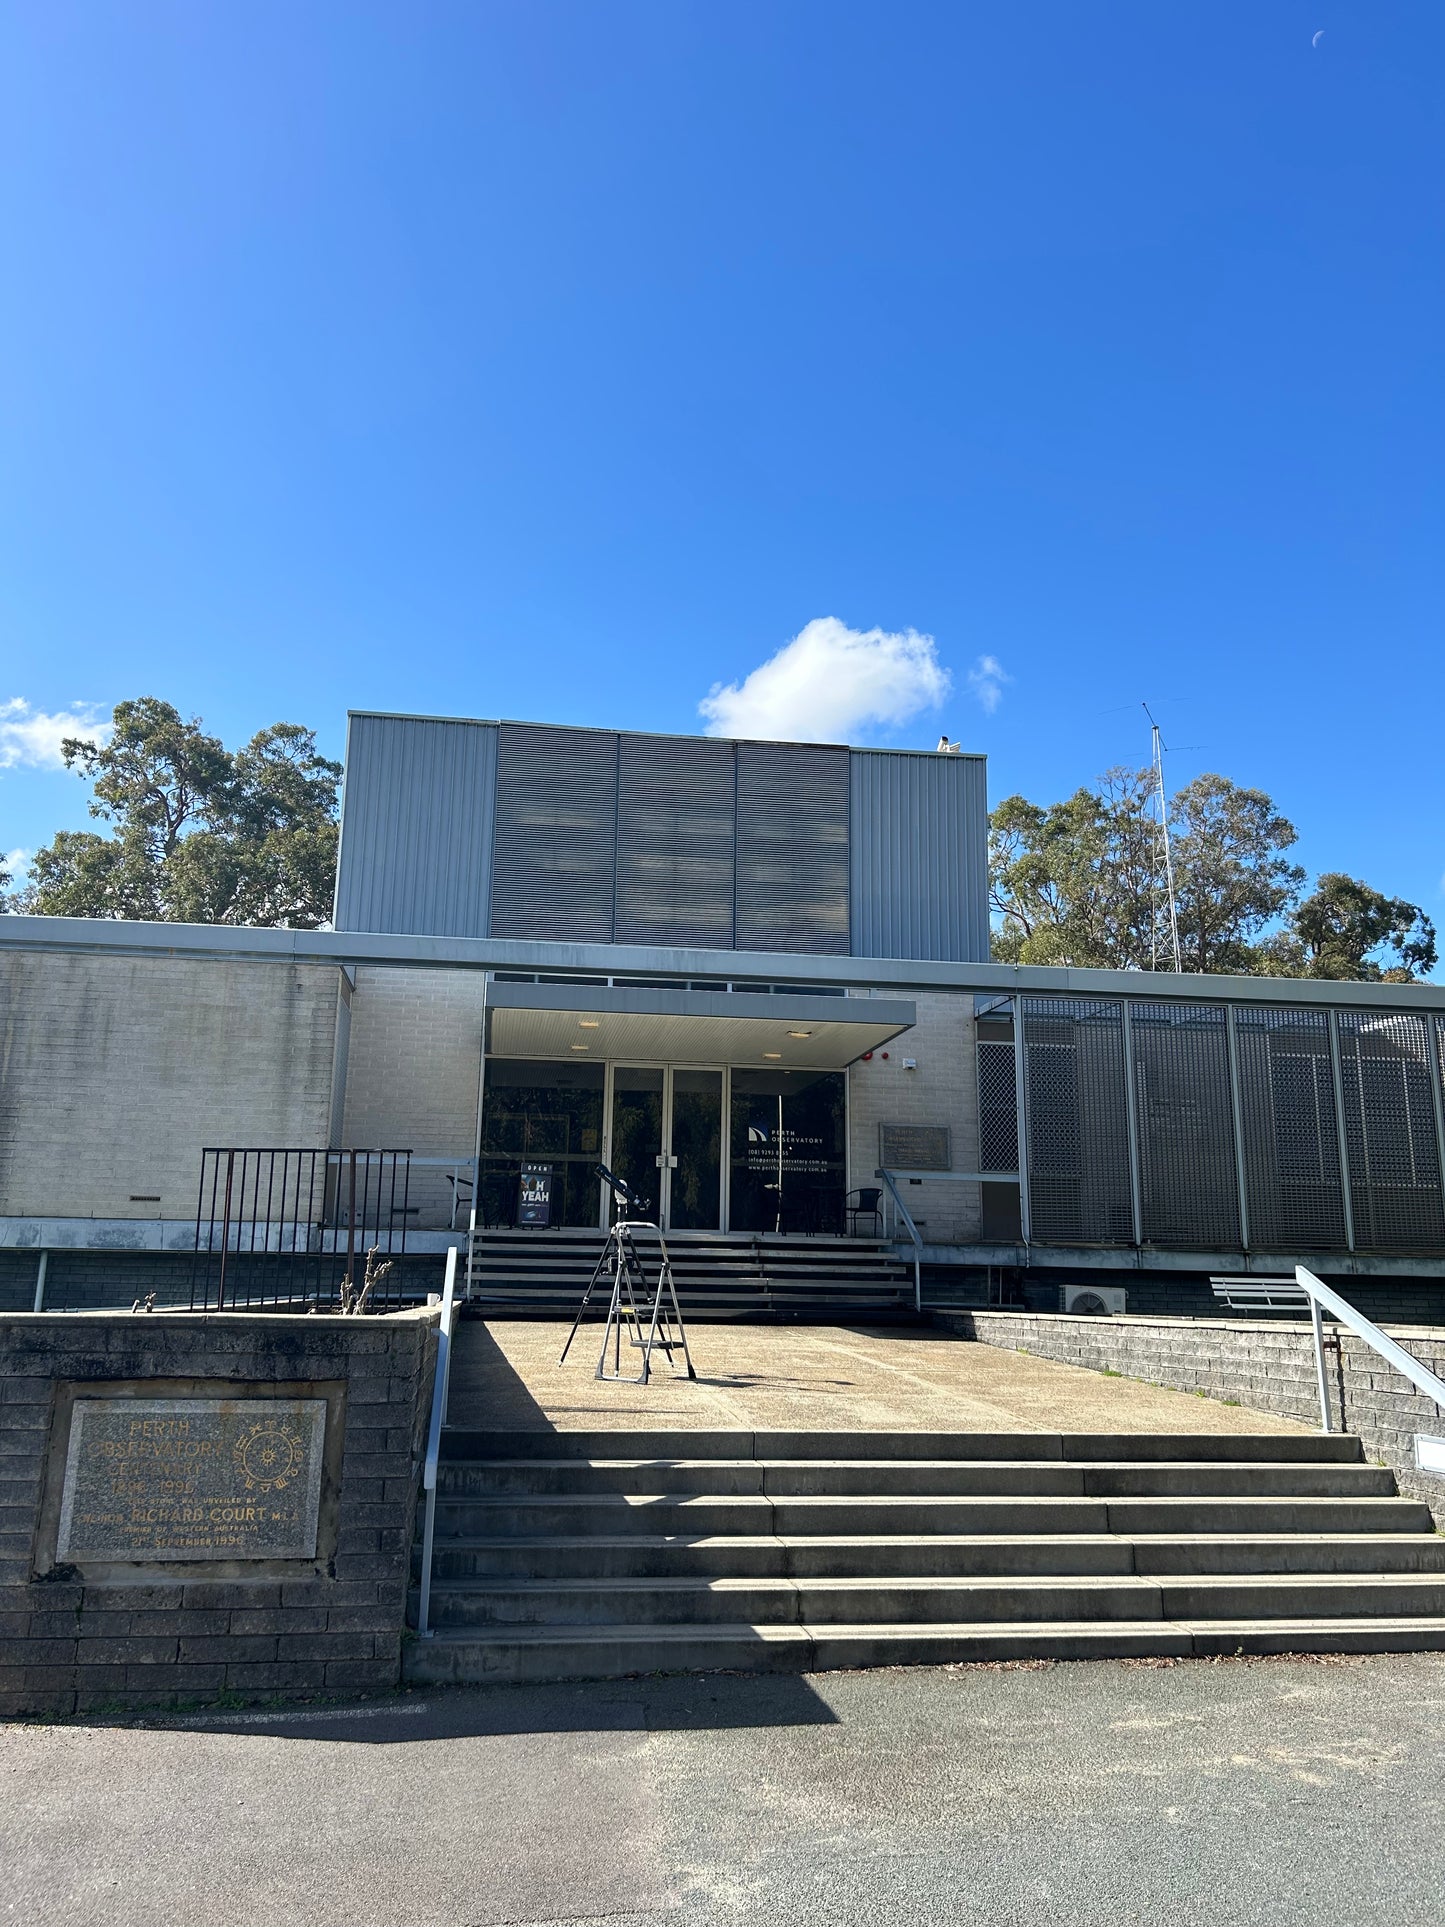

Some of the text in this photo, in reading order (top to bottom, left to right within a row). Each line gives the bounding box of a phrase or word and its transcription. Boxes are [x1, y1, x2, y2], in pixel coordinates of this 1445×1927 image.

[771, 1136, 823, 1144] OBSERVATORY
[522, 1190, 549, 1202] YEAH
[129, 1420, 190, 1437] PERTH
[87, 1440, 225, 1458] OBSERVATORY
[131, 1508, 202, 1524] RICHARD
[210, 1507, 267, 1521] COURT
[215, 1536, 244, 1546] 1996
